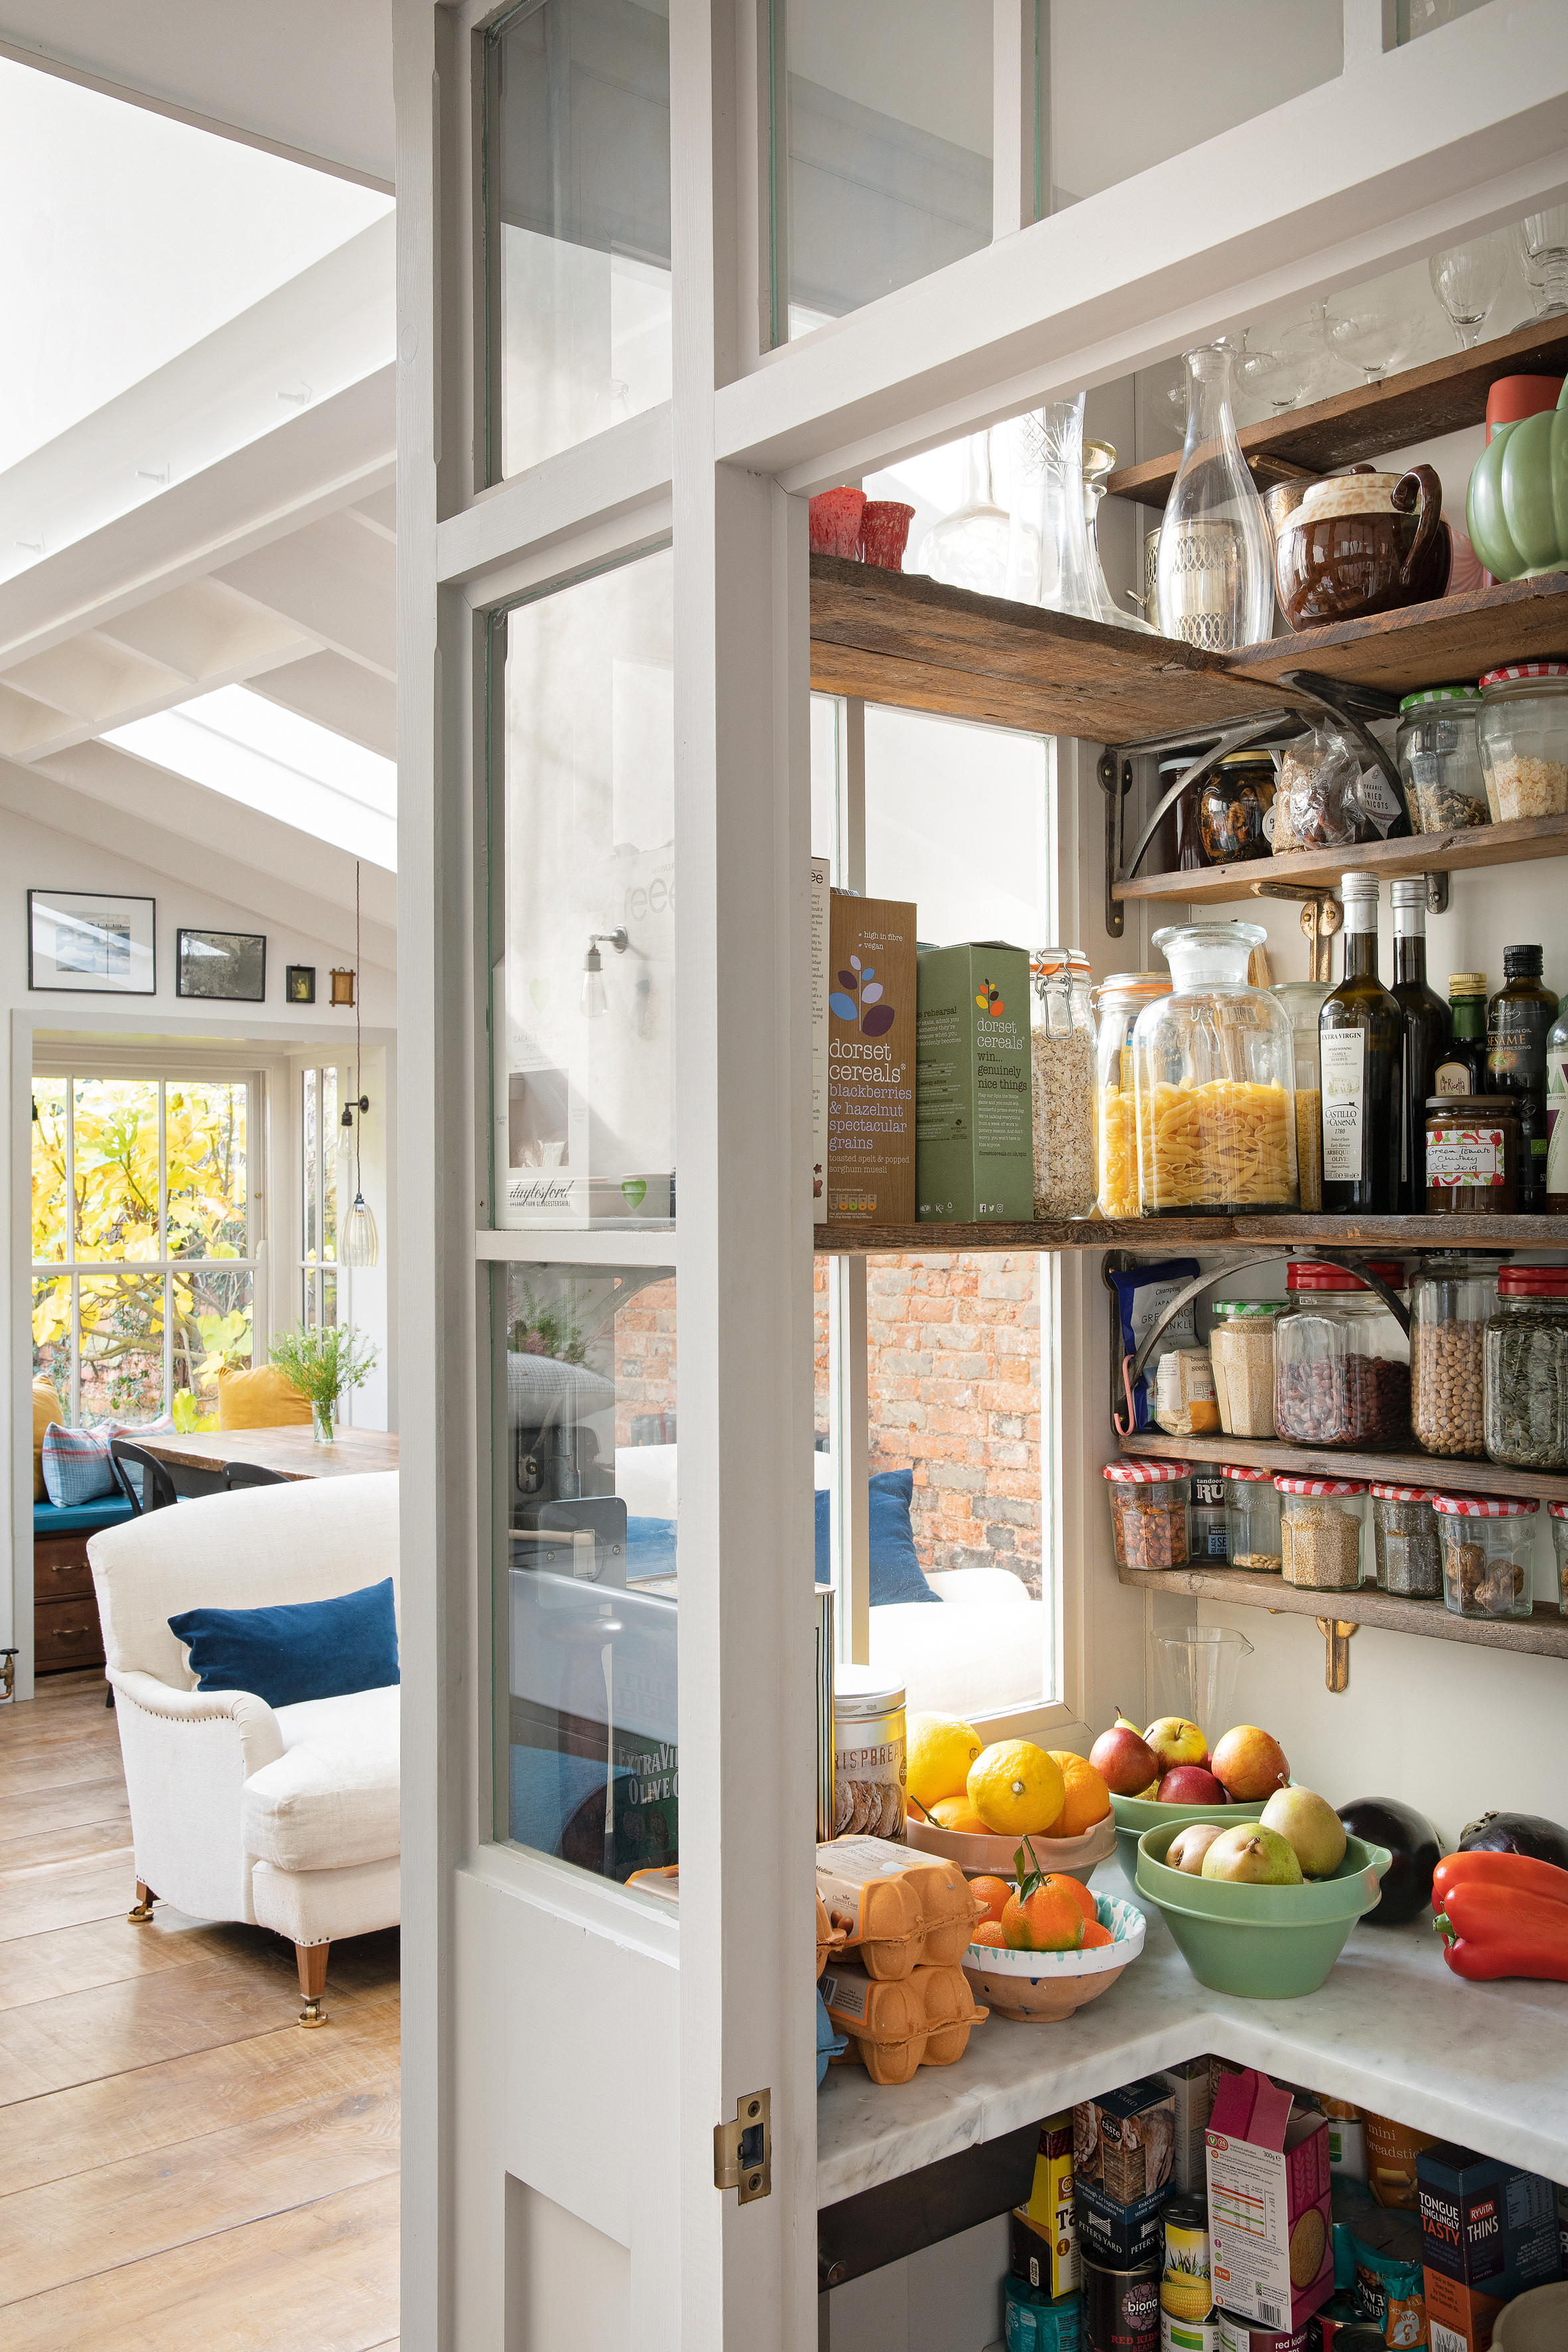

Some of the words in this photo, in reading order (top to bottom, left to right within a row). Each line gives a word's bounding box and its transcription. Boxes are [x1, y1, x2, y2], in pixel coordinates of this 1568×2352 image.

[923, 1006, 957, 1017] rehearsal
[528, 1022, 553, 1032] ORGANIC
[977, 1017, 1017, 1034] dorset
[514, 1034, 532, 1043] CACAO
[540, 1030, 567, 1041] COCONUT
[1487, 1034, 1526, 1046] SESAME
[526, 1042, 554, 1052] PORRIDGE
[829, 1038, 892, 1061] dorset
[977, 1052, 1002, 1062] win...
[978, 1065, 1022, 1079] genuinely
[829, 1083, 911, 1100] blackberries
[978, 1079, 997, 1089] nice
[1000, 1079, 1027, 1093] things
[1448, 1077, 1465, 1095] Ricetta
[829, 1101, 842, 1115] &
[845, 1102, 903, 1117] hazelnut
[1325, 1109, 1357, 1118] CASTILLO
[829, 1119, 907, 1134] spectacular
[1553, 1111, 1565, 1139] VINEGAR
[829, 1137, 873, 1152] grains
[1429, 1146, 1456, 1156] Green
[1459, 1146, 1490, 1154] Tomato
[858, 1155, 876, 1164] spelt
[885, 1156, 909, 1164] popped
[1437, 1155, 1478, 1164] Chutney
[828, 1165, 862, 1174] sorghum
[1156, 1286, 1181, 1295] Clearspring
[629, 1777, 670, 1805] OLIVE
[832, 1895, 848, 1905] Clarence
[847, 1900, 858, 1909] Court
[1118, 2094, 1138, 2108] YARD
[1102, 2121, 1121, 2138] taste
[1368, 2124, 1396, 2140] mini
[1366, 2135, 1423, 2159] breadstic
[1263, 2151, 1275, 2160] 300g
[1064, 2180, 1072, 2189] 20
[1075, 2180, 1097, 2198] Sourdough
[1098, 2195, 1125, 2215] Crispbread
[1083, 2191, 1095, 2202] SEEDED
[1095, 2201, 1117, 2216] WHOLEGRAIN
[1135, 2208, 1147, 2217] SEEDED
[1419, 2191, 1459, 2222] TONGUE
[1419, 2205, 1459, 2230] TINGLINGLY
[1421, 2214, 1460, 2246] TASTY
[1467, 2215, 1499, 2242] THINS
[1535, 2224, 1554, 2236] Ingredients
[1079, 2221, 1102, 2241] PETER'S
[1103, 2236, 1123, 2254] YARD
[1131, 2235, 1155, 2254] PETER'S
[1060, 2242, 1066, 2254] 1
[1129, 2298, 1157, 2312] biona
[1130, 2307, 1156, 2315] ORGANIC
[1403, 2324, 1413, 2341] 3
[1111, 2335, 1134, 2345] RED
[1133, 2341, 1156, 2352] BEANS
